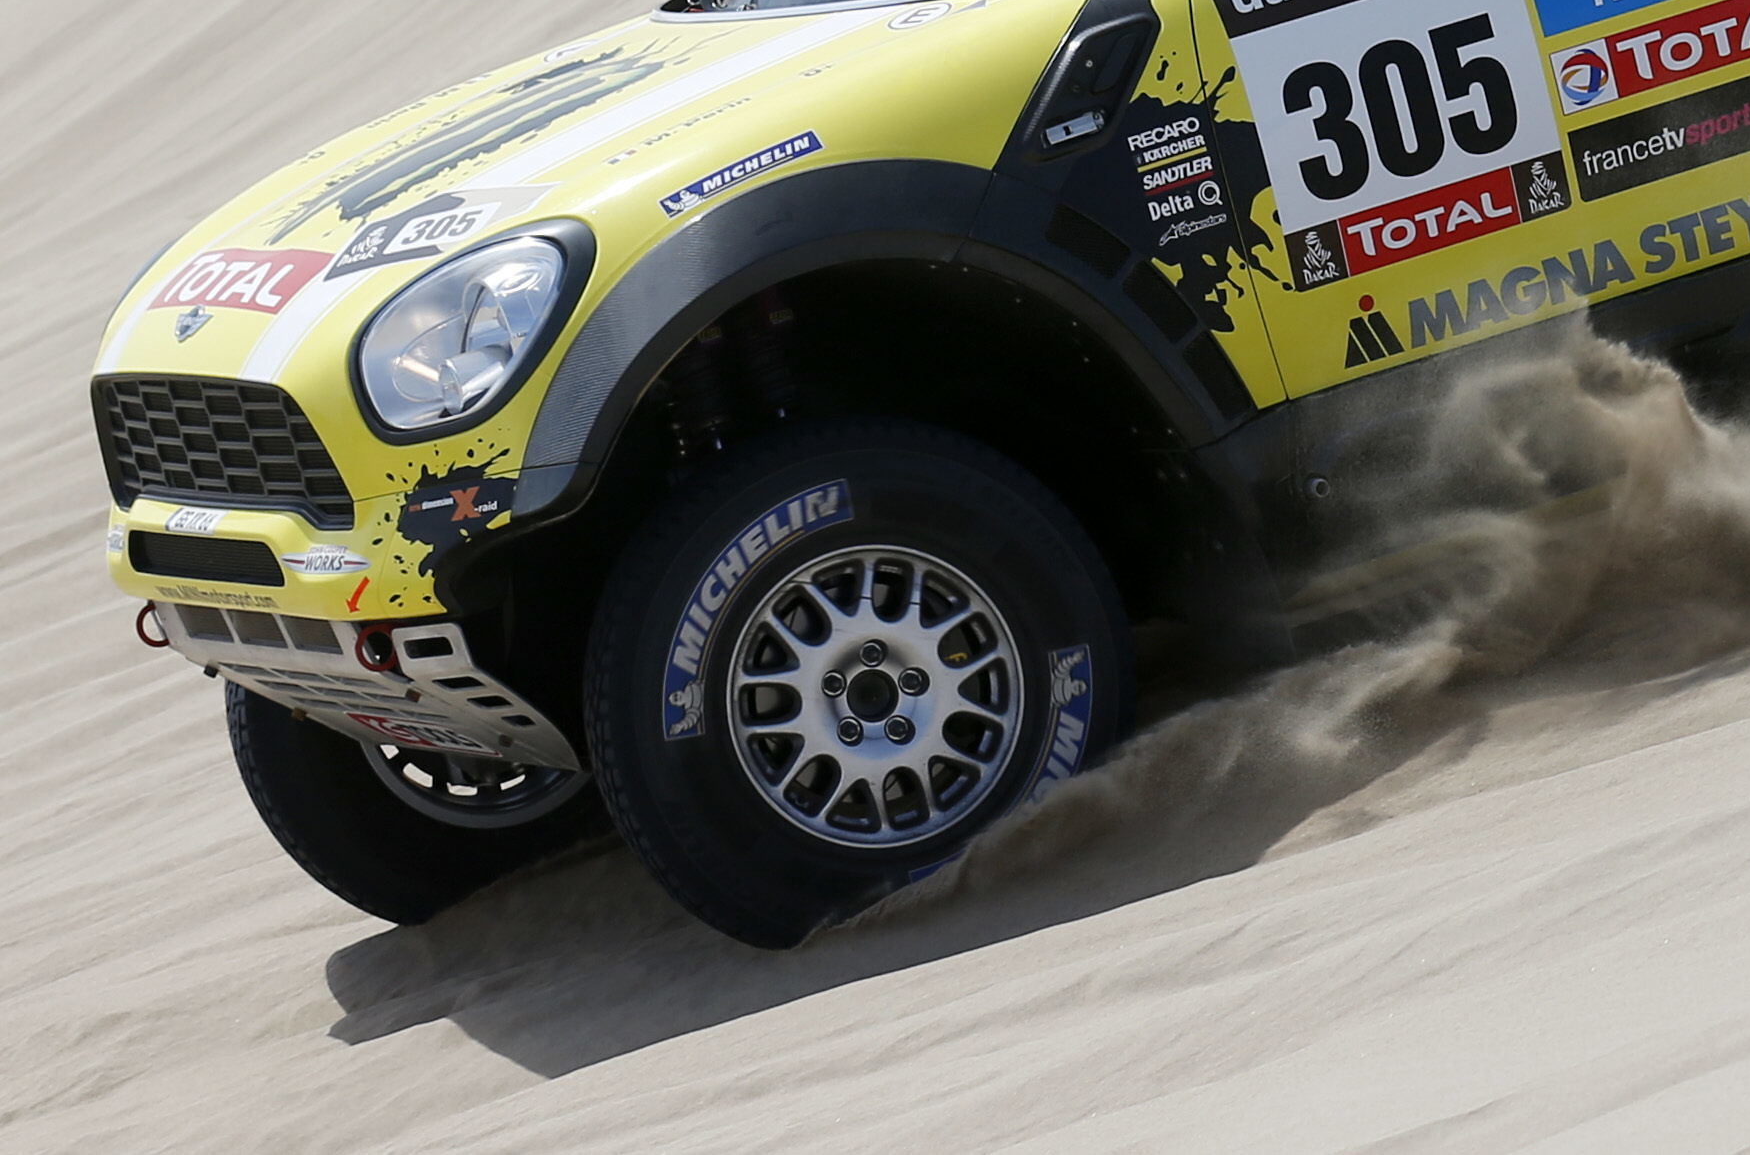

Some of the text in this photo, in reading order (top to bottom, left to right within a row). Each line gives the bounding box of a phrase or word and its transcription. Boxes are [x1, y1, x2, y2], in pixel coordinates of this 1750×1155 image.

[1282, 12, 1518, 201] 305
[1127, 117, 1200, 151] RECARO
[702, 136, 811, 194] MICHELIN
[1143, 156, 1213, 191] SANDTLER
[1148, 195, 1195, 222] Delta
[1527, 192, 1565, 215] DAKAR
[401, 210, 483, 245] 305
[1346, 192, 1513, 257] TOTAL
[163, 252, 294, 307] TOTAL
[1303, 262, 1340, 285] DAKAR
[1408, 239, 1636, 349] MAGNA
[304, 554, 345, 571] WORKS
[672, 485, 840, 675] MICHELIN
